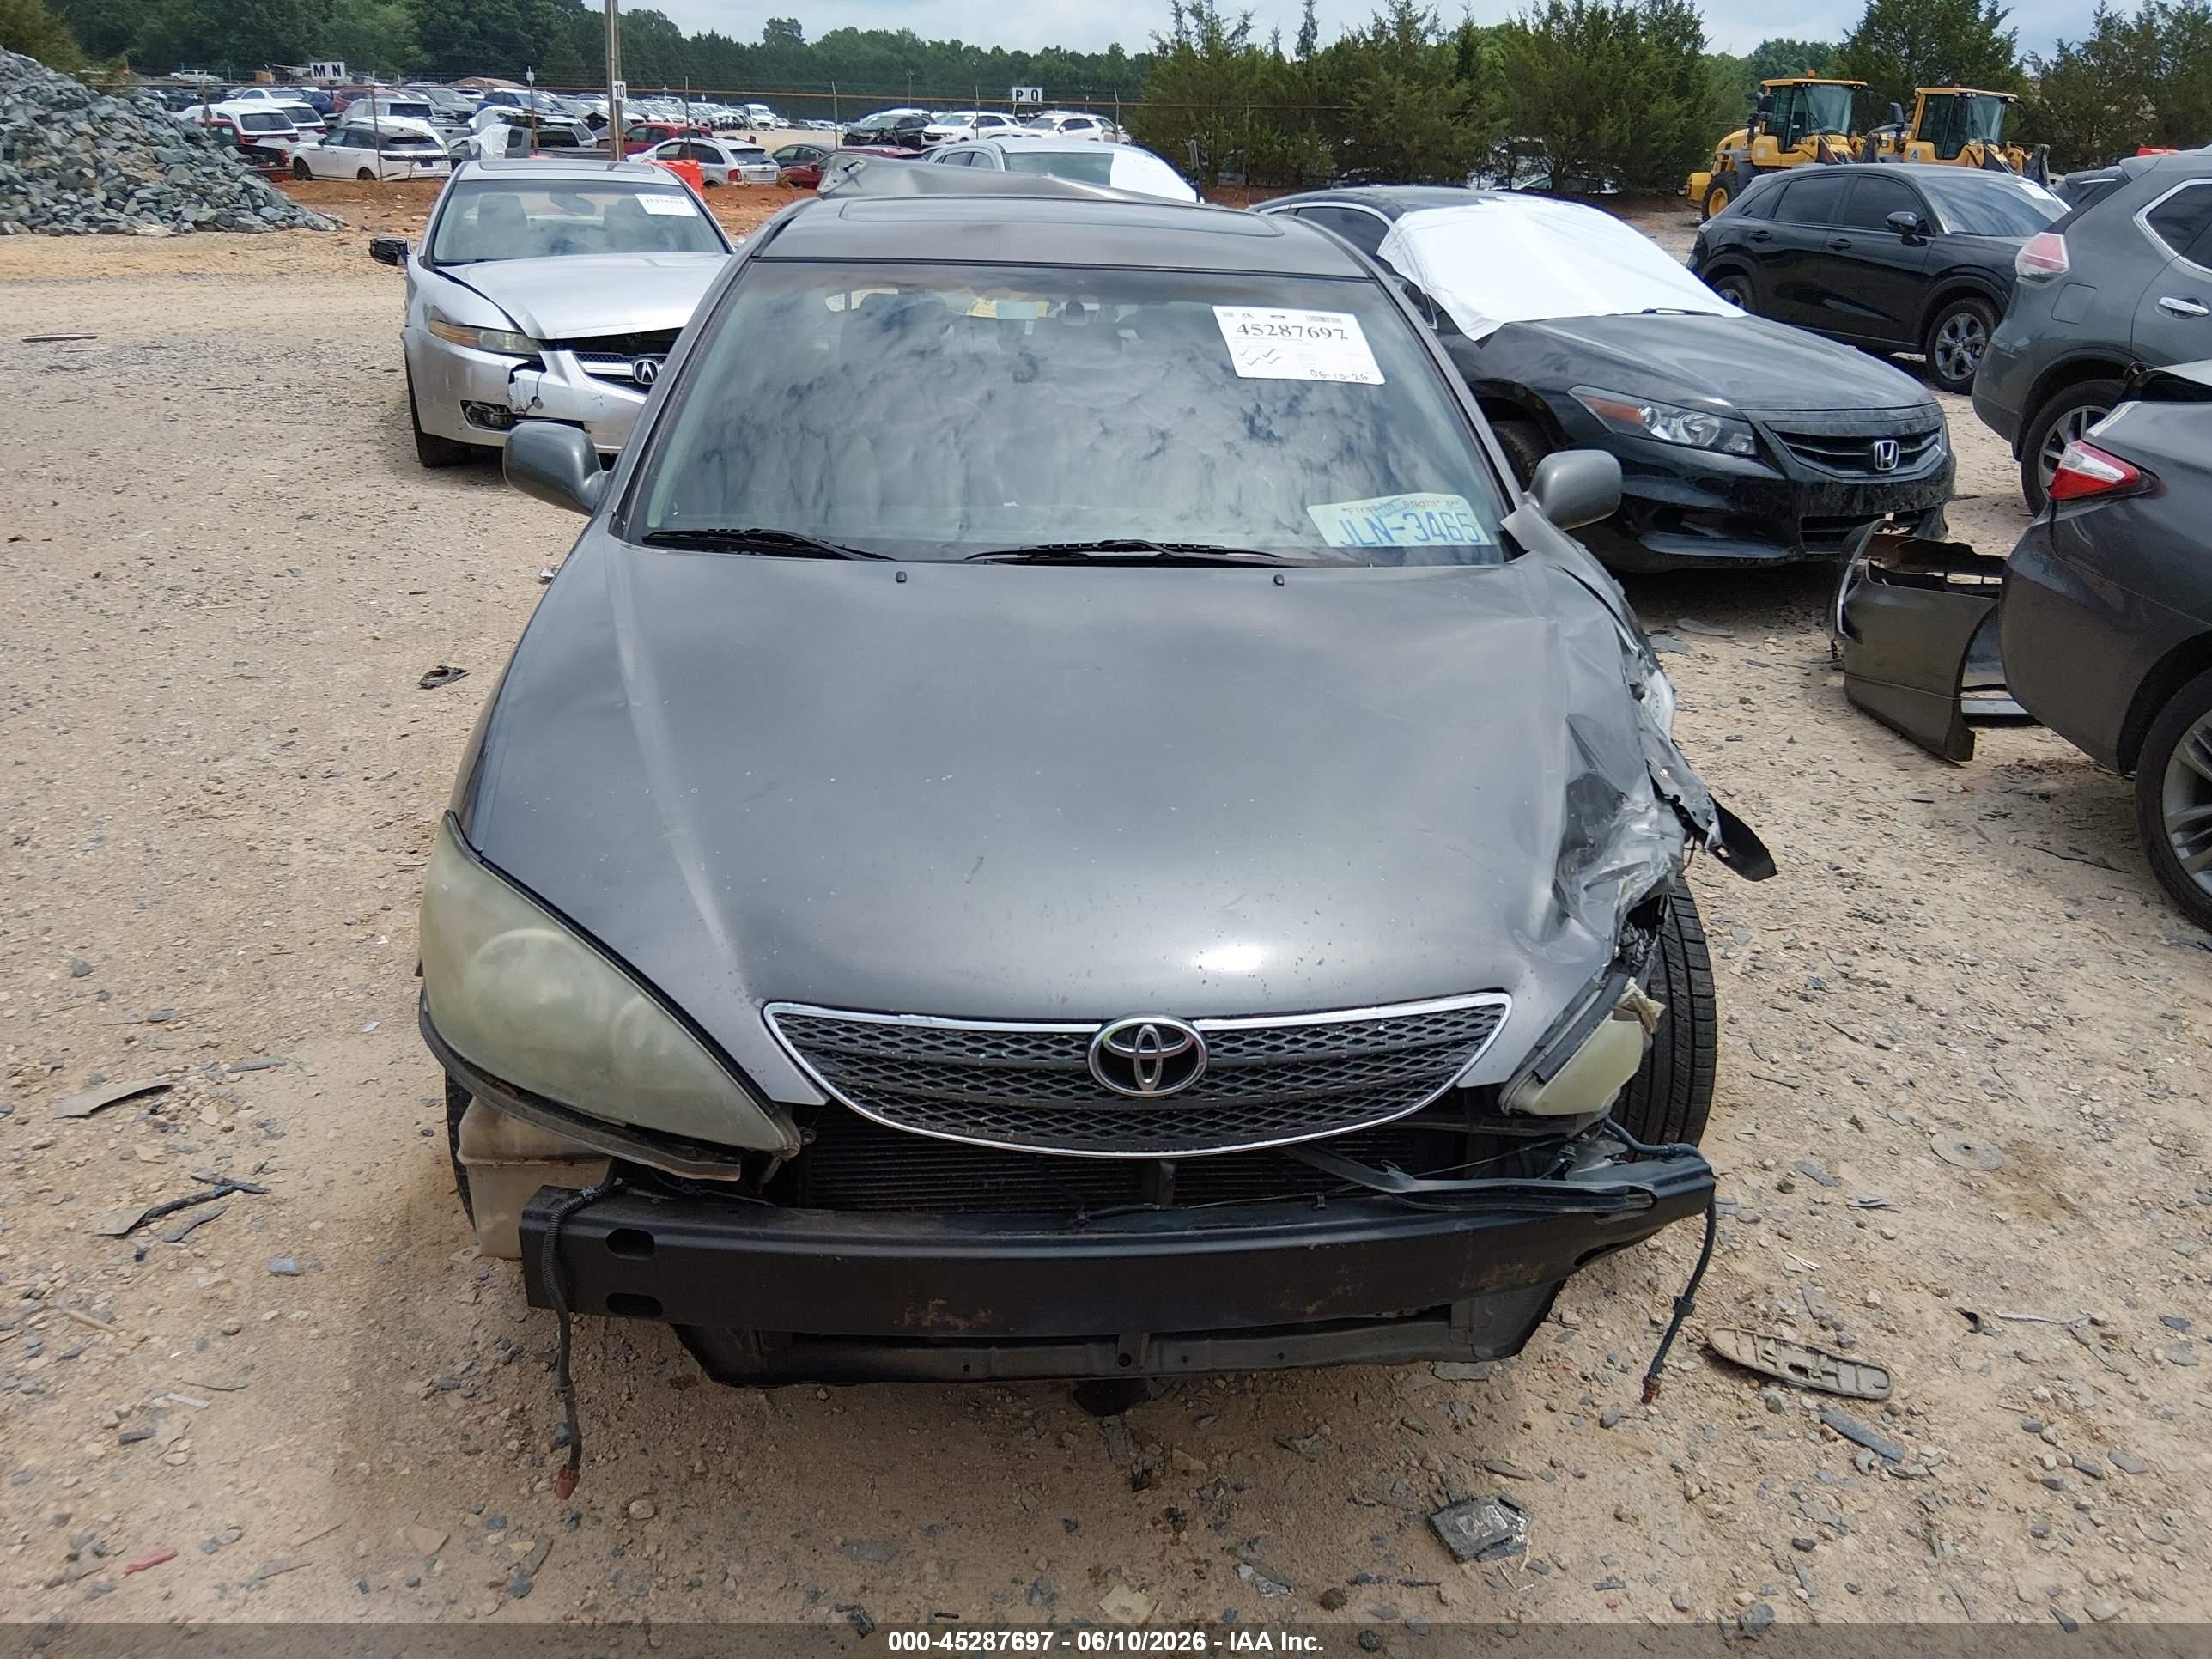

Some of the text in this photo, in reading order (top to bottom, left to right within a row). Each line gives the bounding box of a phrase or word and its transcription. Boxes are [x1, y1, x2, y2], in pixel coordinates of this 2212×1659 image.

[313, 64, 342, 77] M N
[615, 84, 625, 98] 10
[1016, 89, 1024, 102] P
[1237, 323, 1349, 341] 45287697
[1339, 513, 1480, 546] JLN-3465
